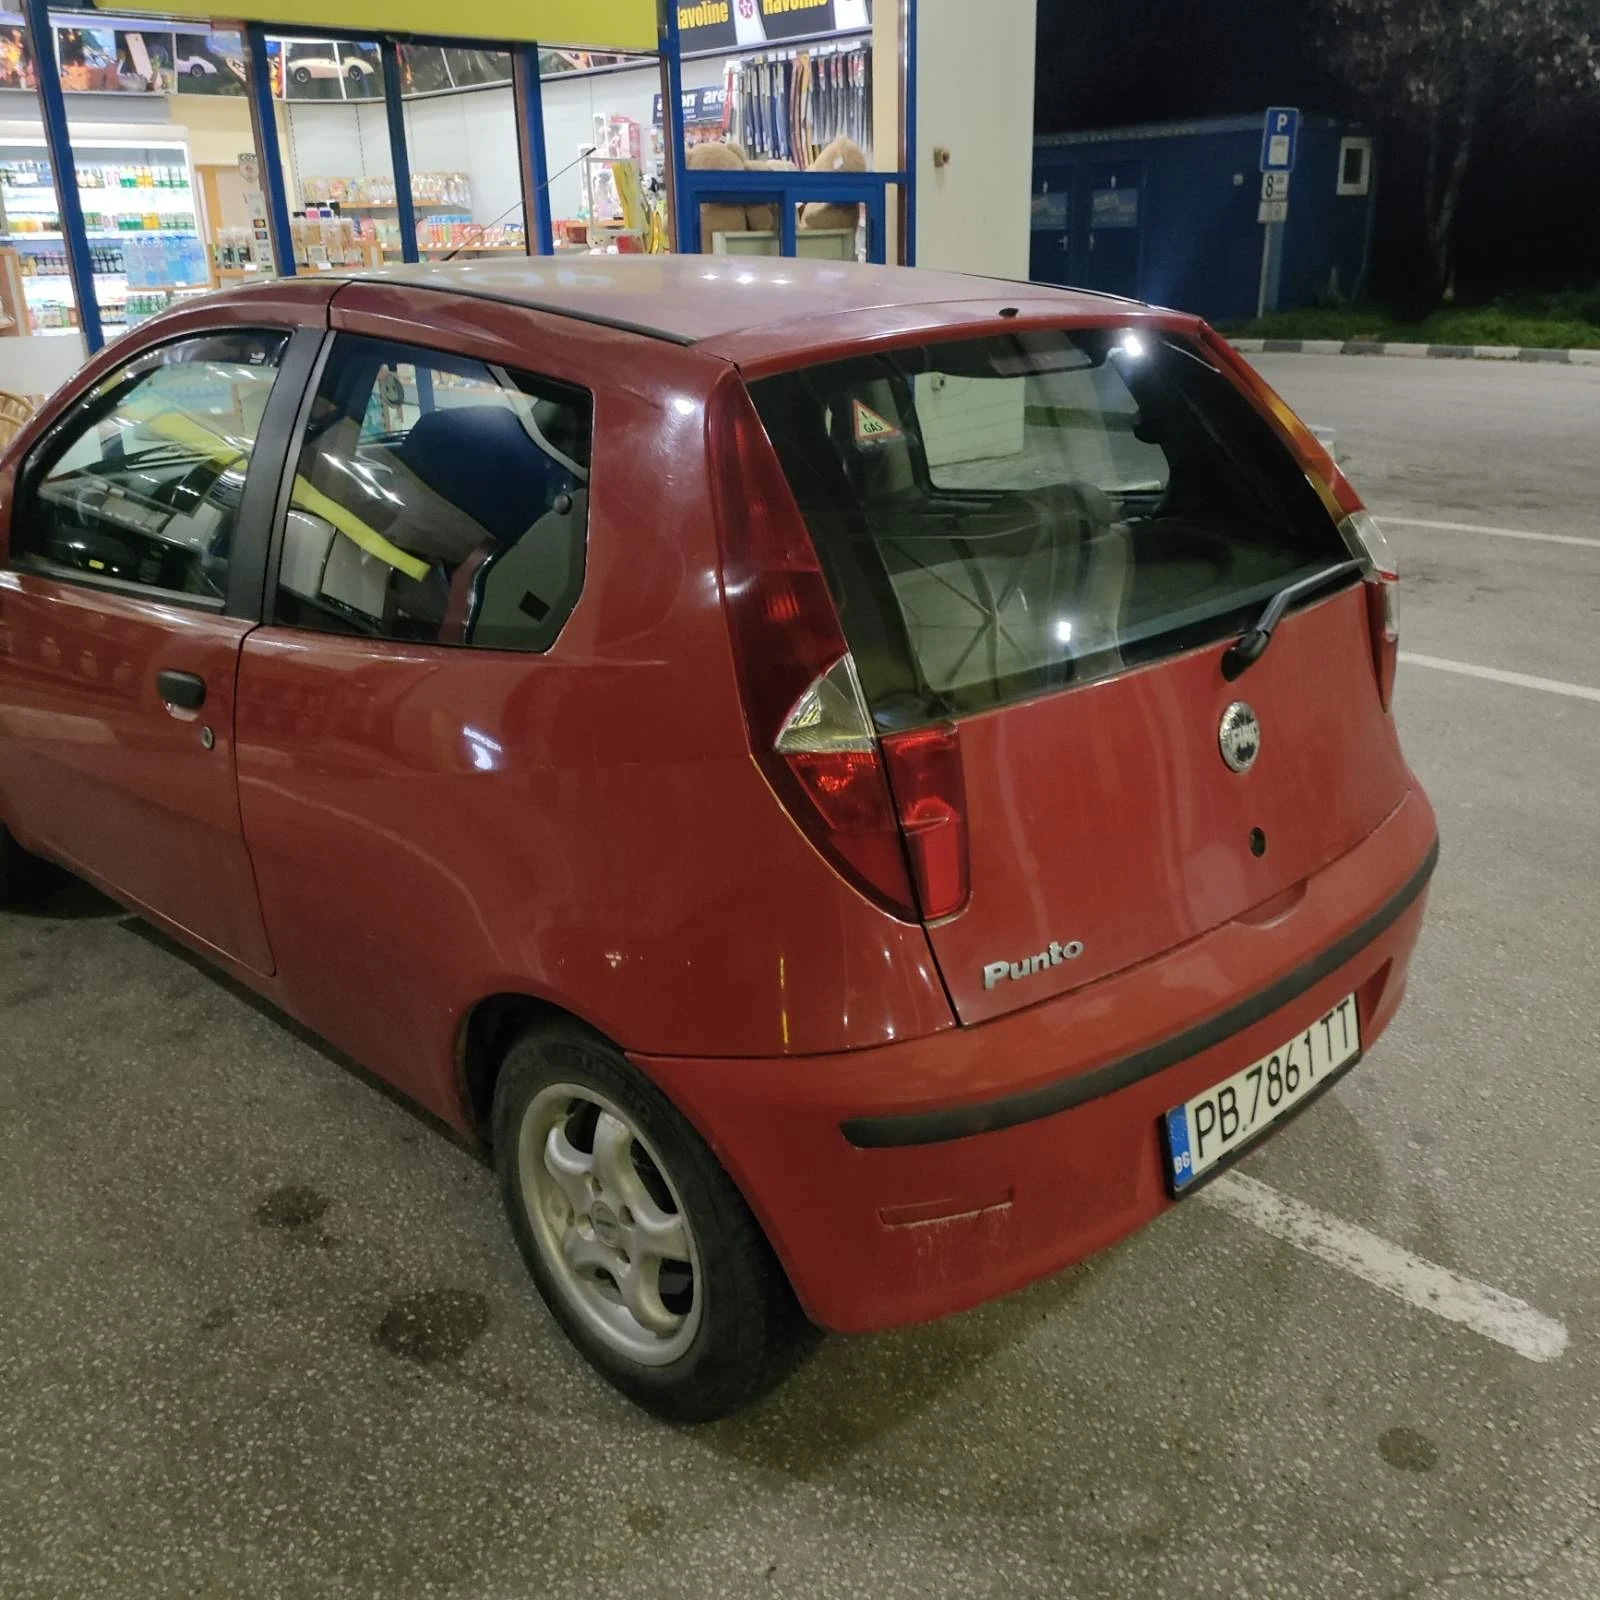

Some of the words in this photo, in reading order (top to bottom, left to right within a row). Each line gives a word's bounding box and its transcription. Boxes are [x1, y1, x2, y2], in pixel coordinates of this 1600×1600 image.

[1276, 113, 1288, 132] P
[1265, 175, 1274, 198] 8
[863, 422, 884, 433] GAS
[983, 941, 1084, 990] Punto
[1173, 1151, 1191, 1175] BG
